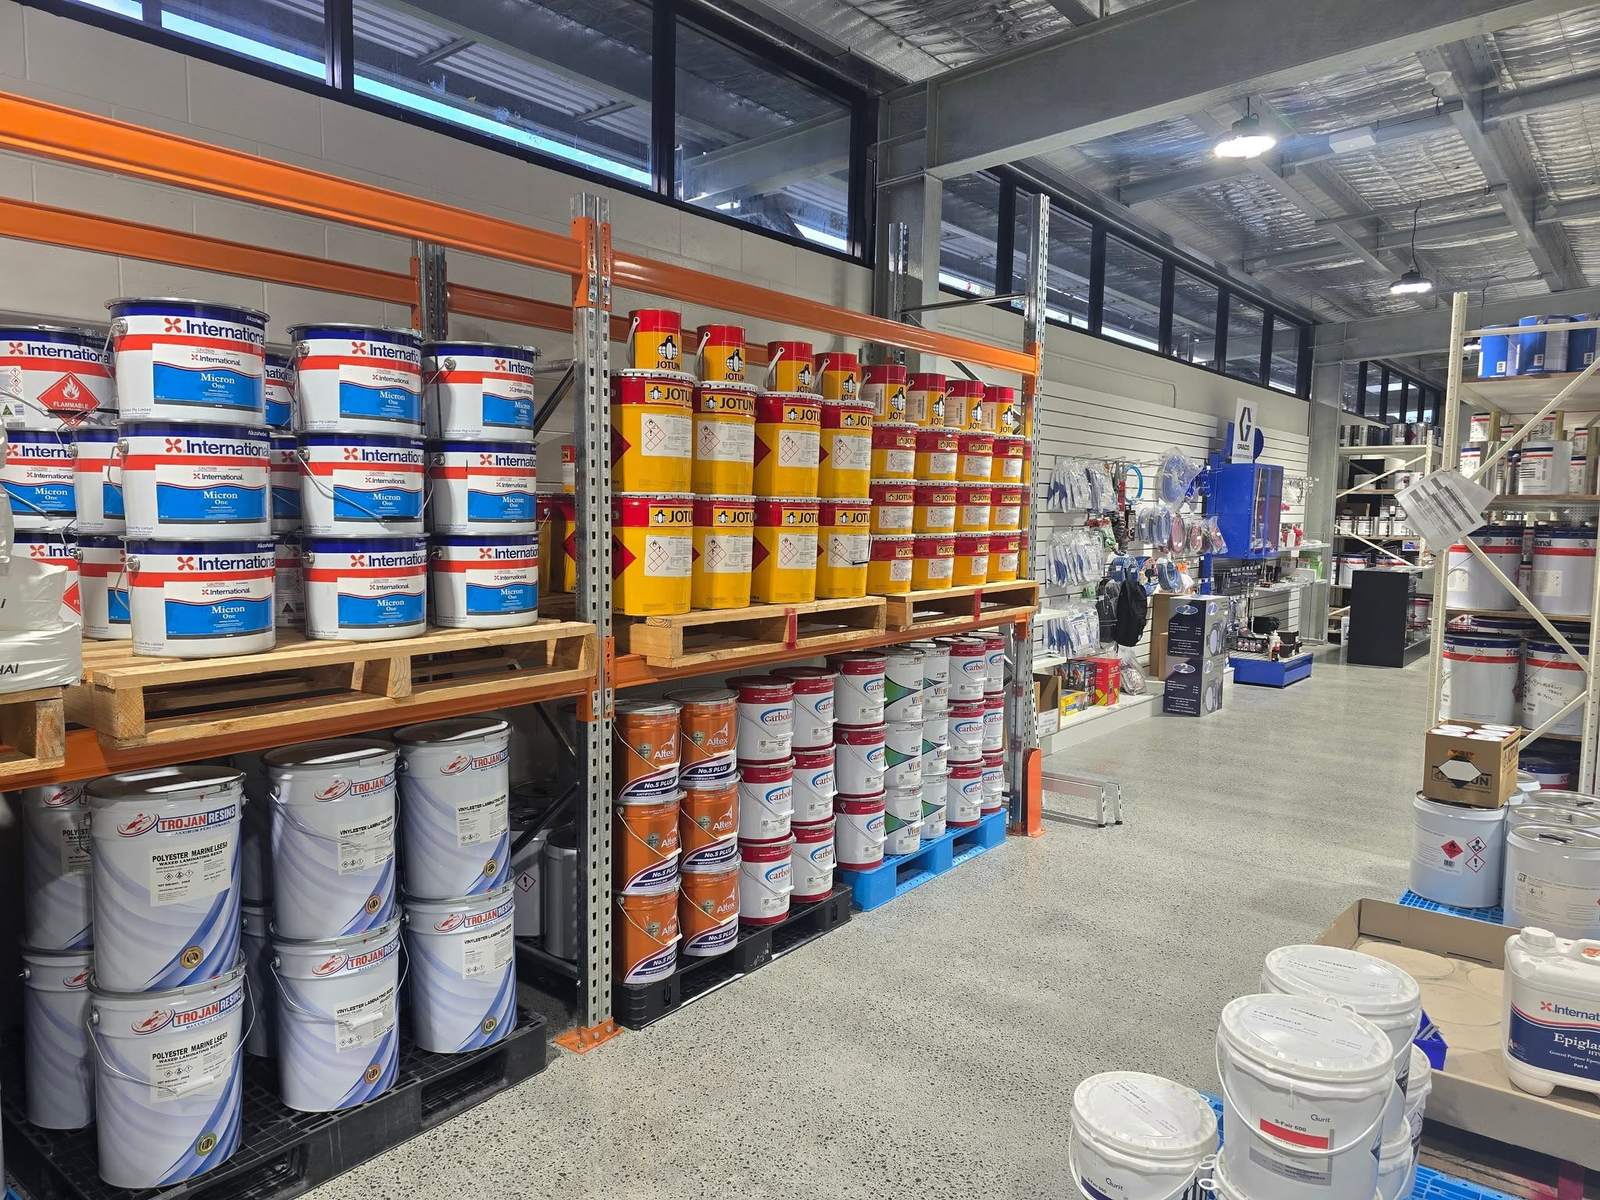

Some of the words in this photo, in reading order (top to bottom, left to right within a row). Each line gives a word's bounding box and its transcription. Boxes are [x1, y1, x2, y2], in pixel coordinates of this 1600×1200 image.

[197, 354, 242, 367] International
[200, 372, 235, 385] Micron
[379, 390, 406, 401] Micron
[53, 401, 89, 409] FLAMMABLE
[719, 397, 754, 411] JOTUN
[201, 473, 244, 481] International
[35, 487, 68, 496] Micron
[203, 490, 238, 500] Micron
[373, 492, 401, 501] Micron
[208, 587, 251, 596] International
[500, 588, 524, 596] Micron
[377, 599, 405, 608] Micron
[211, 605, 246, 615] Micron
[707, 737, 729, 746] Altex
[712, 765, 728, 773] PLUS
[659, 779, 674, 787] PLUS
[159, 813, 207, 831] TROJAN
[207, 804, 236, 823] RESINS
[712, 820, 733, 831] Altex
[152, 851, 189, 863] POLYESTER
[191, 845, 214, 857] MARINE
[719, 848, 732, 857] PLUS
[159, 859, 179, 867] WAXED
[716, 902, 735, 914] Altex
[466, 908, 498, 926] TROJAN
[350, 948, 385, 968] TROJAN
[175, 1002, 219, 1026] TROJAN
[152, 1046, 188, 1061] POLYESTER
[191, 1039, 213, 1052] MARINE
